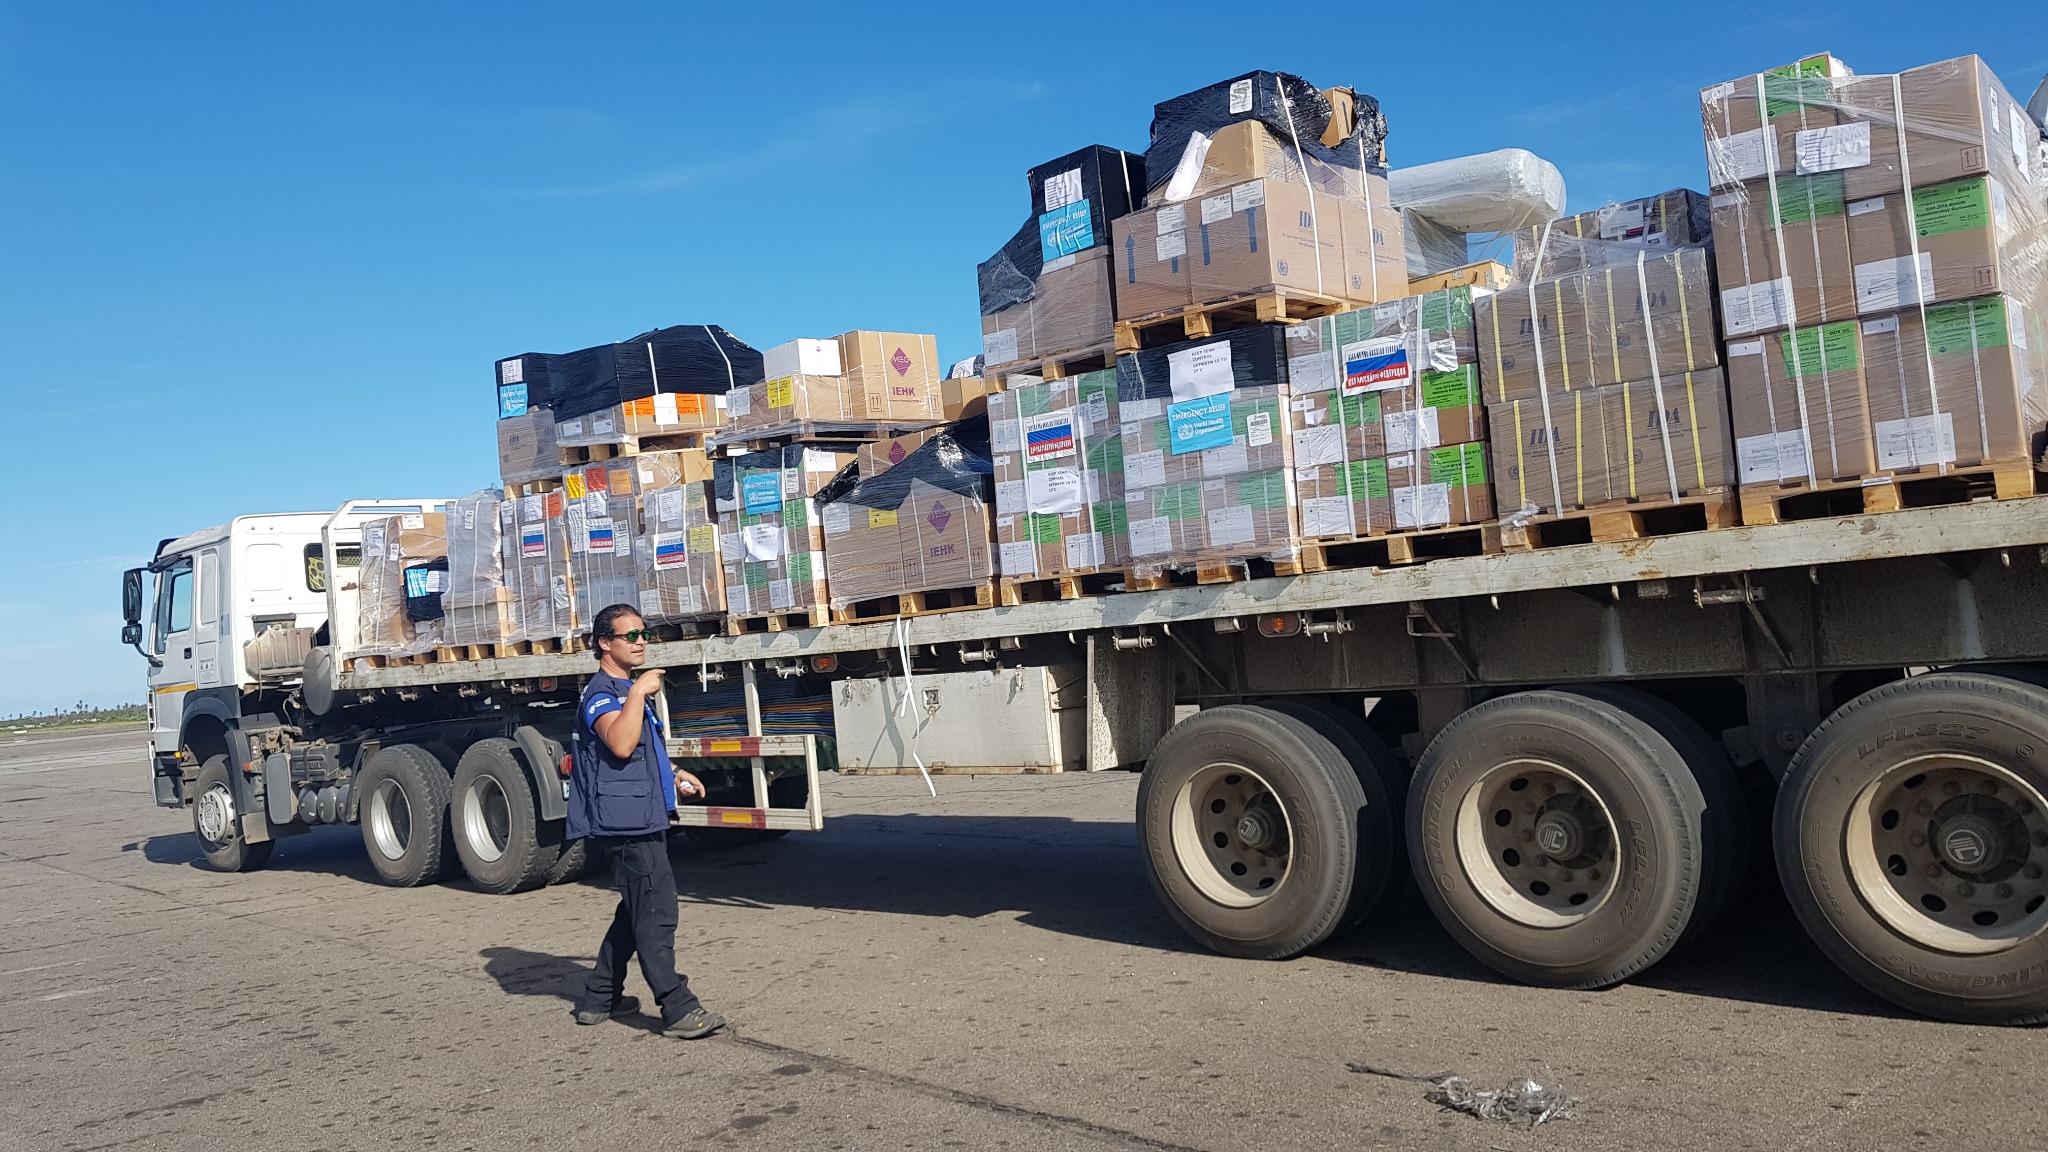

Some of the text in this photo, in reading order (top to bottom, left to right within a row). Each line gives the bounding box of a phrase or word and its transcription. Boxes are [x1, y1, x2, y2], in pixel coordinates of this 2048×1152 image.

[890, 355, 911, 363] MEG
[1192, 360, 1214, 368] BETWEEN
[892, 386, 916, 396] IEHK
[1171, 403, 1226, 421] EMERGENCY RELIEF
[1193, 417, 1224, 429] World Health
[1194, 424, 1225, 436] Organization
[929, 543, 956, 557] IEHK
